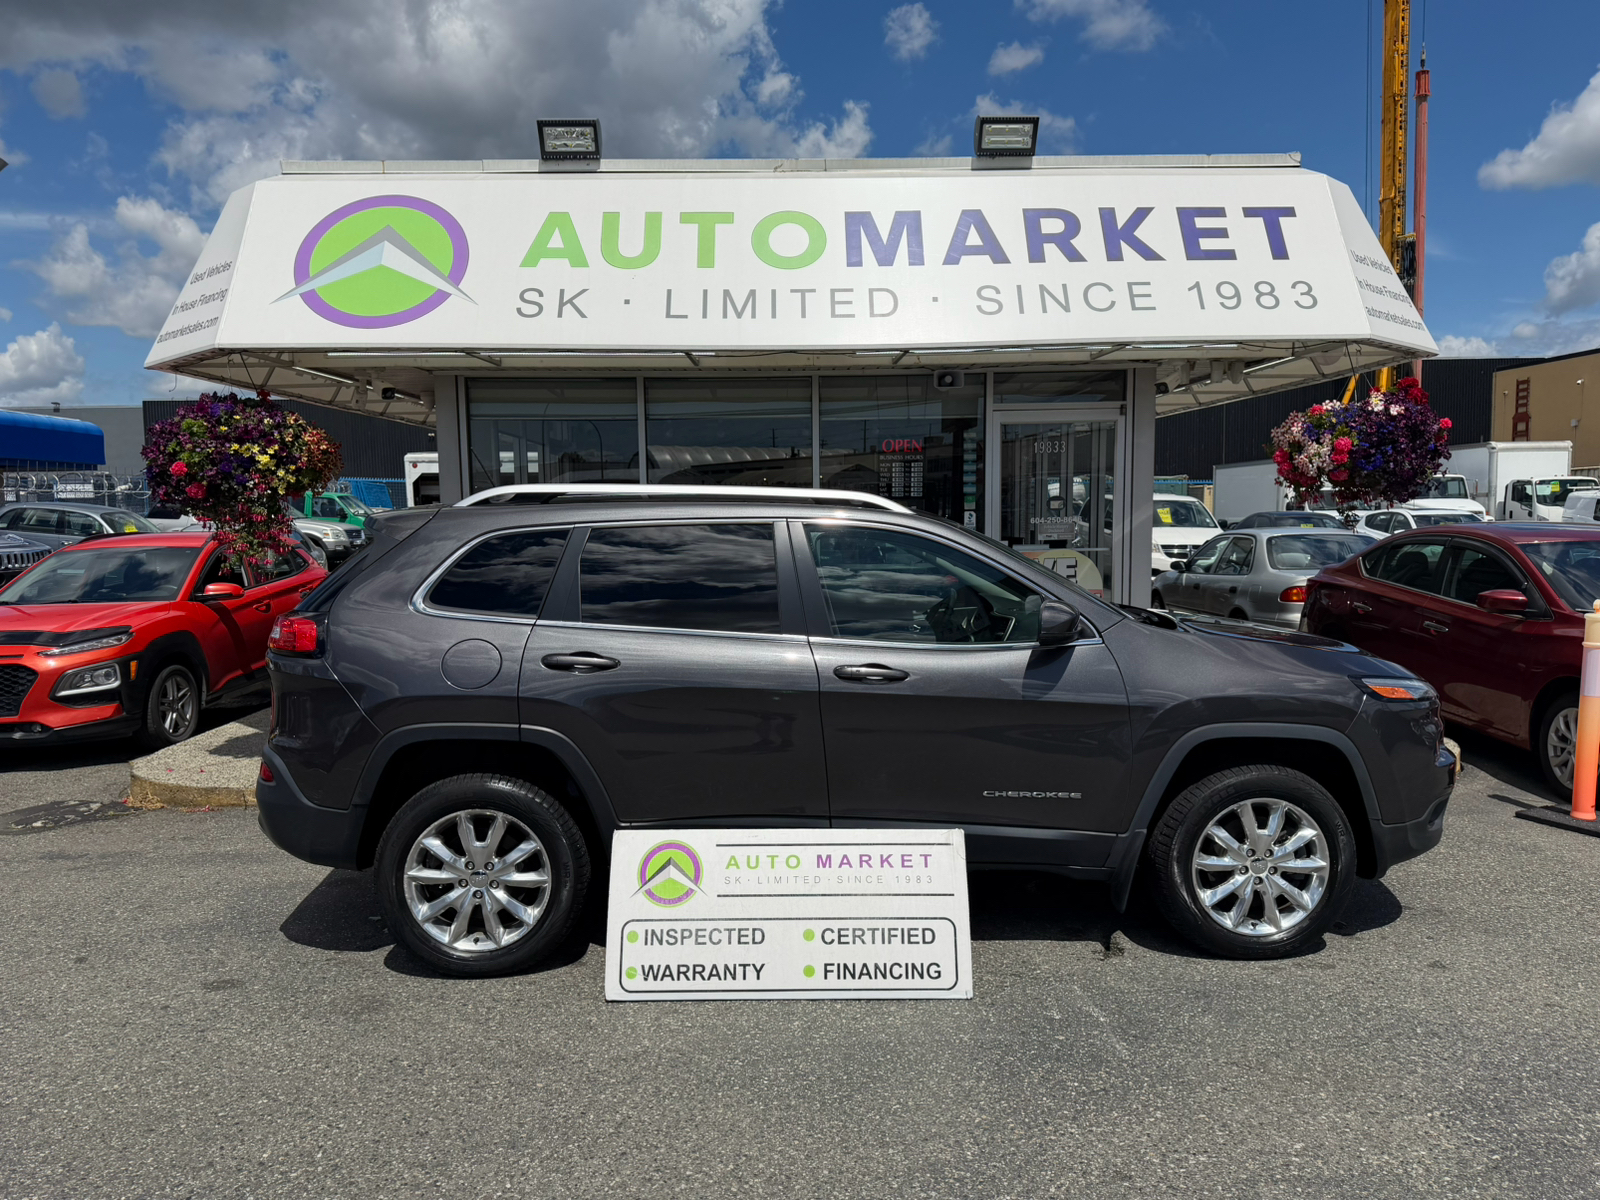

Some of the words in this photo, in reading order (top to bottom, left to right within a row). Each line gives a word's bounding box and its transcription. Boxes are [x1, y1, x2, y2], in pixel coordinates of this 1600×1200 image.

[1350, 249, 1370, 267] Used
[1366, 255, 1393, 275] Vehicles
[190, 270, 207, 284] Used
[206, 260, 232, 279] Vehicles
[1362, 278, 1386, 297] House
[178, 300, 198, 313] House
[197, 288, 228, 307] Financing
[515, 287, 590, 319] SK
[664, 287, 899, 319] LIMITED
[975, 280, 1157, 317] SINCE
[1186, 279, 1319, 311] 1983
[1365, 306, 1426, 331] automarketsales.com
[157, 316, 219, 344] automarketsales.com
[882, 439, 922, 452] OPEN
[1033, 440, 1067, 454] 19833
[982, 790, 1082, 799] CHEROKEE
[724, 854, 802, 870] AUTO
[815, 853, 935, 869] MARKET
[723, 876, 742, 885] SK
[757, 875, 822, 885] LIMITED
[837, 875, 884, 884] SINCE
[894, 875, 935, 884] 1983
[643, 927, 766, 946] INSPECTED
[820, 927, 936, 946] CERTIFIED
[640, 963, 766, 982] WARRANTY
[823, 962, 942, 980] FINANCING
